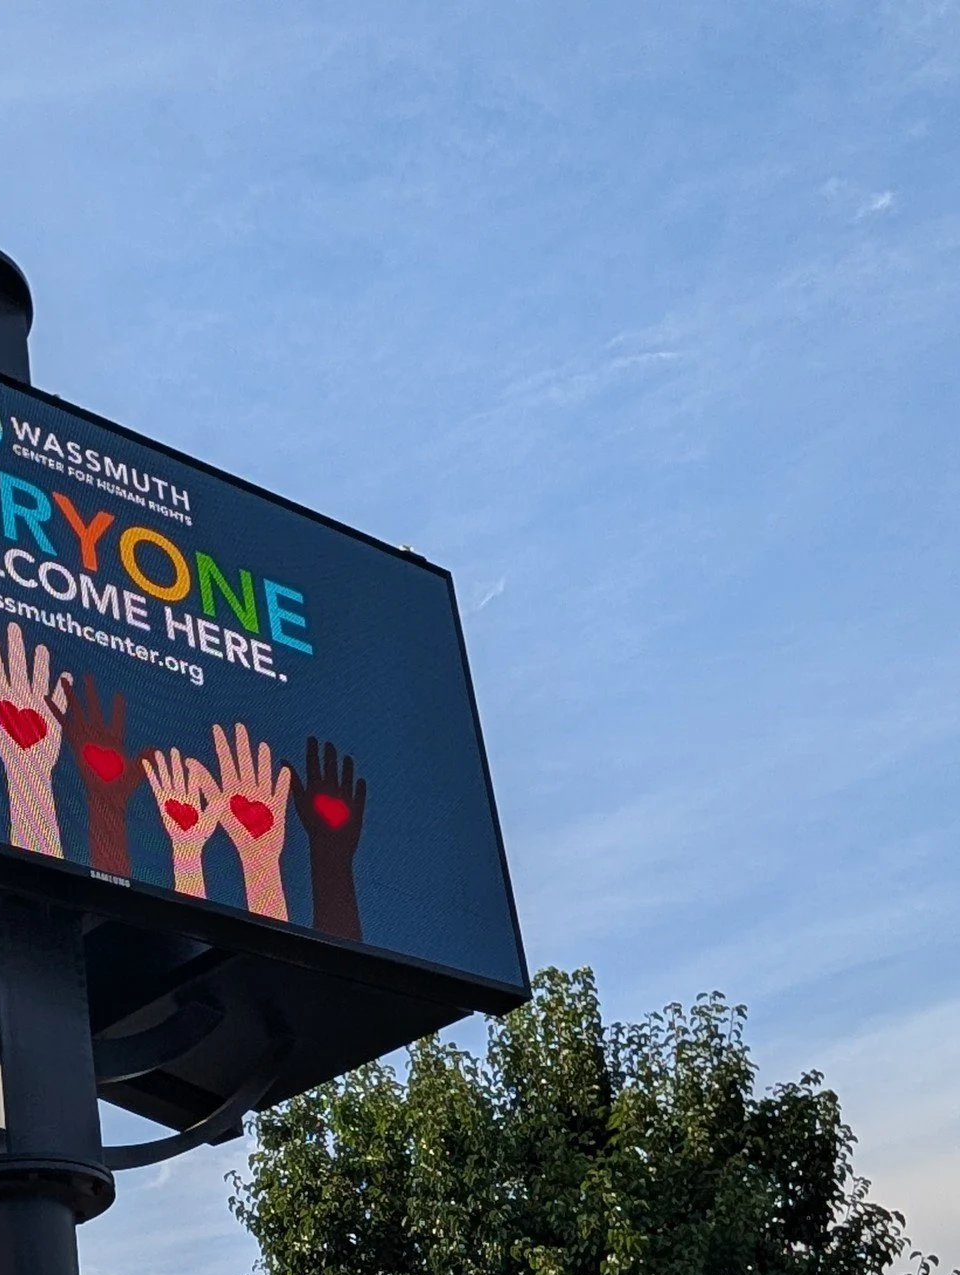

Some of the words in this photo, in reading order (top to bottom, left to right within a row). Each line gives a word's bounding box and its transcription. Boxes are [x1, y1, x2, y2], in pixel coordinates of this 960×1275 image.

[10, 416, 191, 511] WASSMUTH
[12, 443, 65, 474] CENTER
[68, 466, 94, 488] FOR
[96, 478, 146, 507] HUMAN
[148, 501, 193, 527] RIGHTS
[163, 605, 289, 683] HERE.
